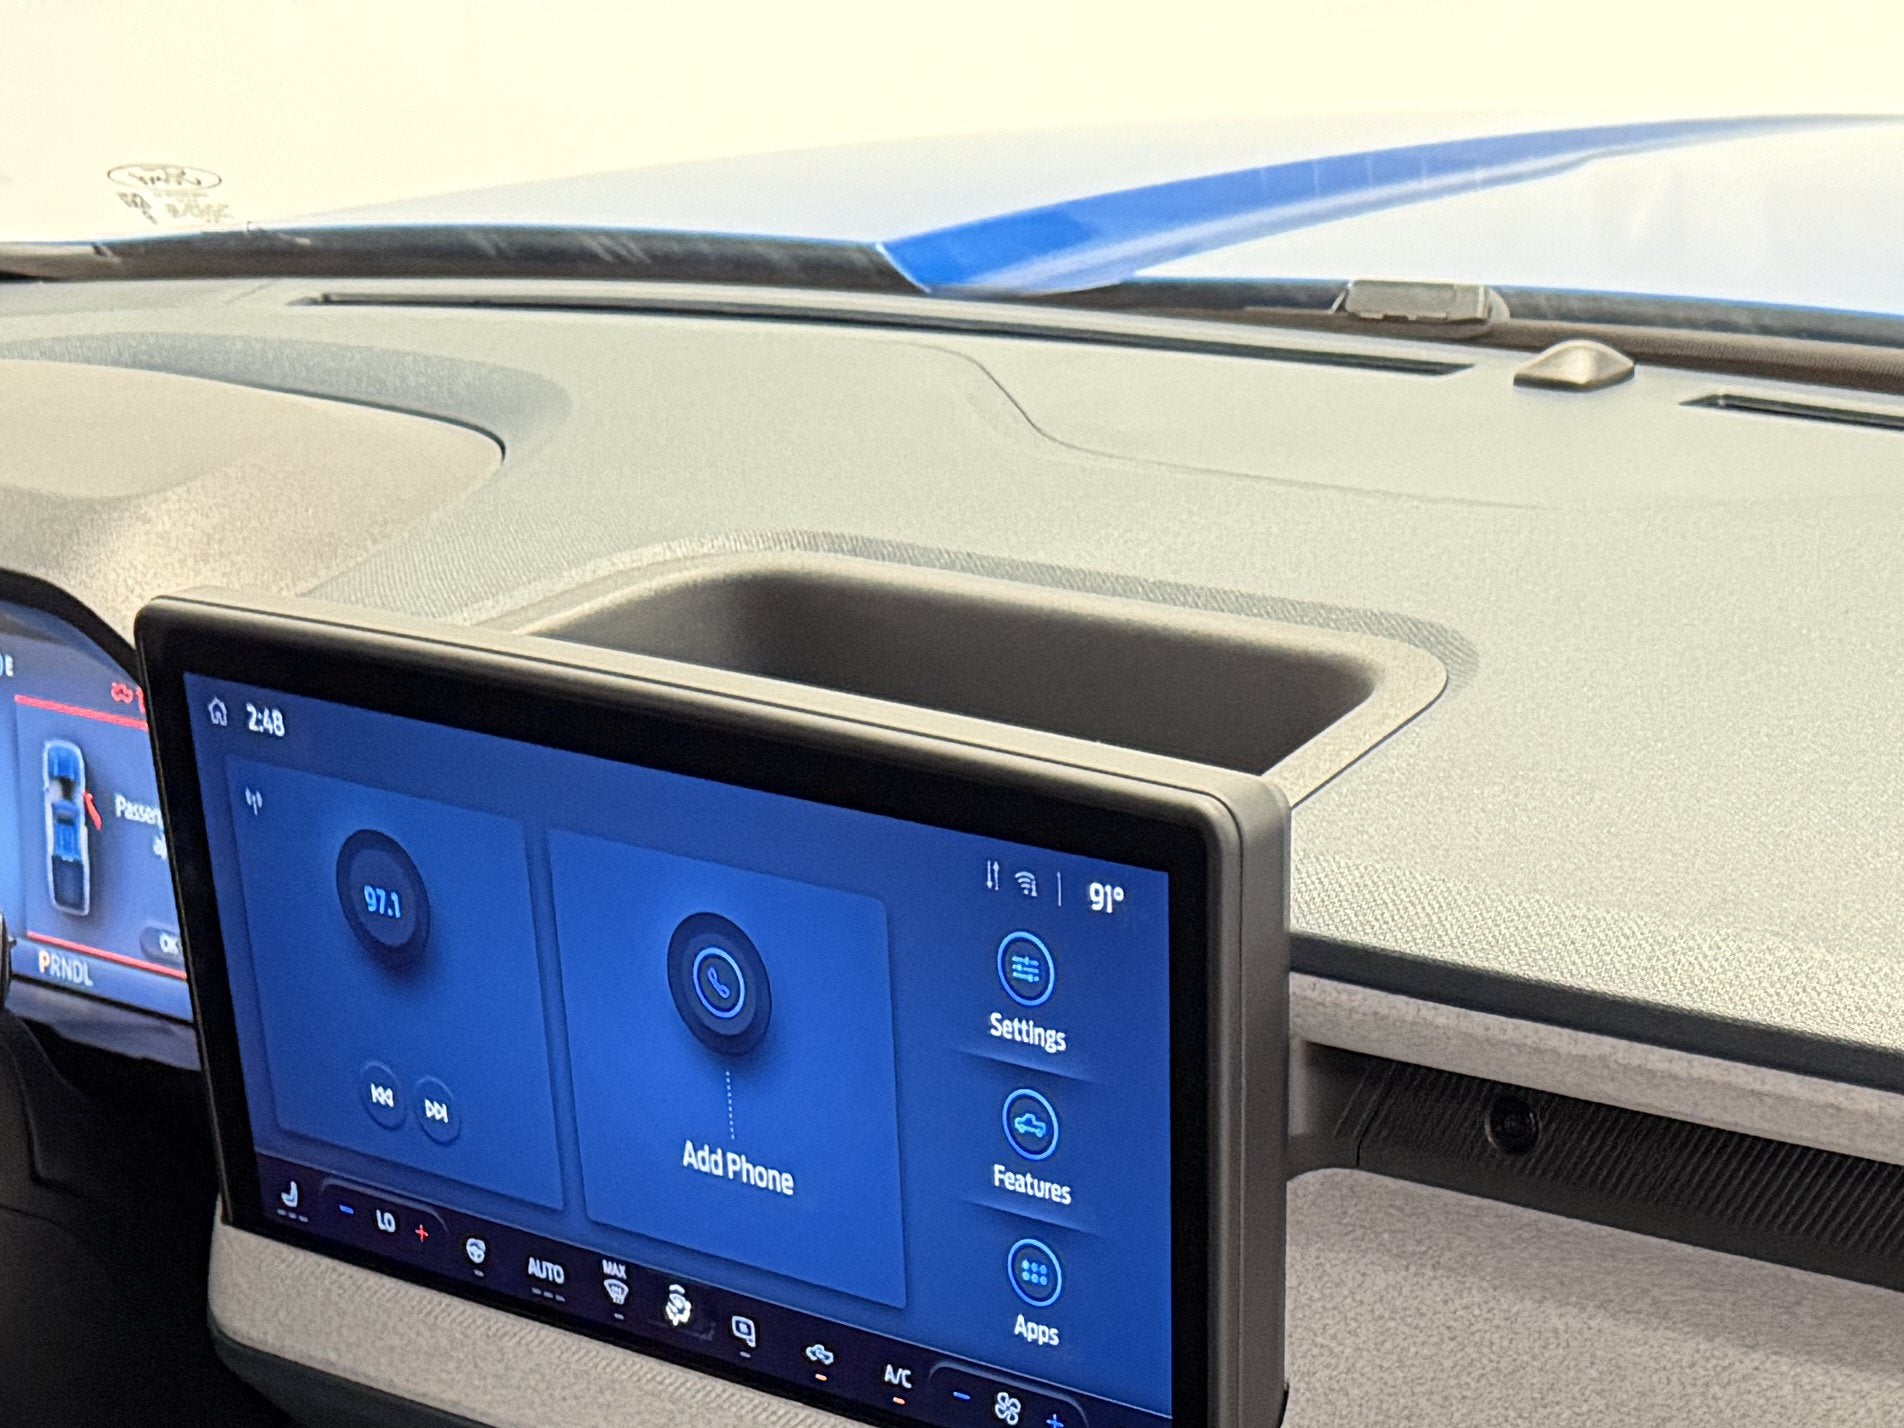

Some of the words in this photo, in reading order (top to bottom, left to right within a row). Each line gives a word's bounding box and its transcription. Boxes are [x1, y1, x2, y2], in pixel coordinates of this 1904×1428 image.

[246, 702, 285, 737] 2:48
[364, 885, 401, 918] 97.1
[990, 1012, 1067, 1054] Settings
[683, 1139, 723, 1176] Add
[726, 1151, 794, 1196] Phone
[993, 1163, 1072, 1205] Features
[376, 1209, 396, 1233] LO
[528, 1257, 565, 1284] AUTO
[602, 1259, 628, 1280] MAX
[1014, 1314, 1059, 1346] Apps
[884, 1363, 912, 1389] A/C
